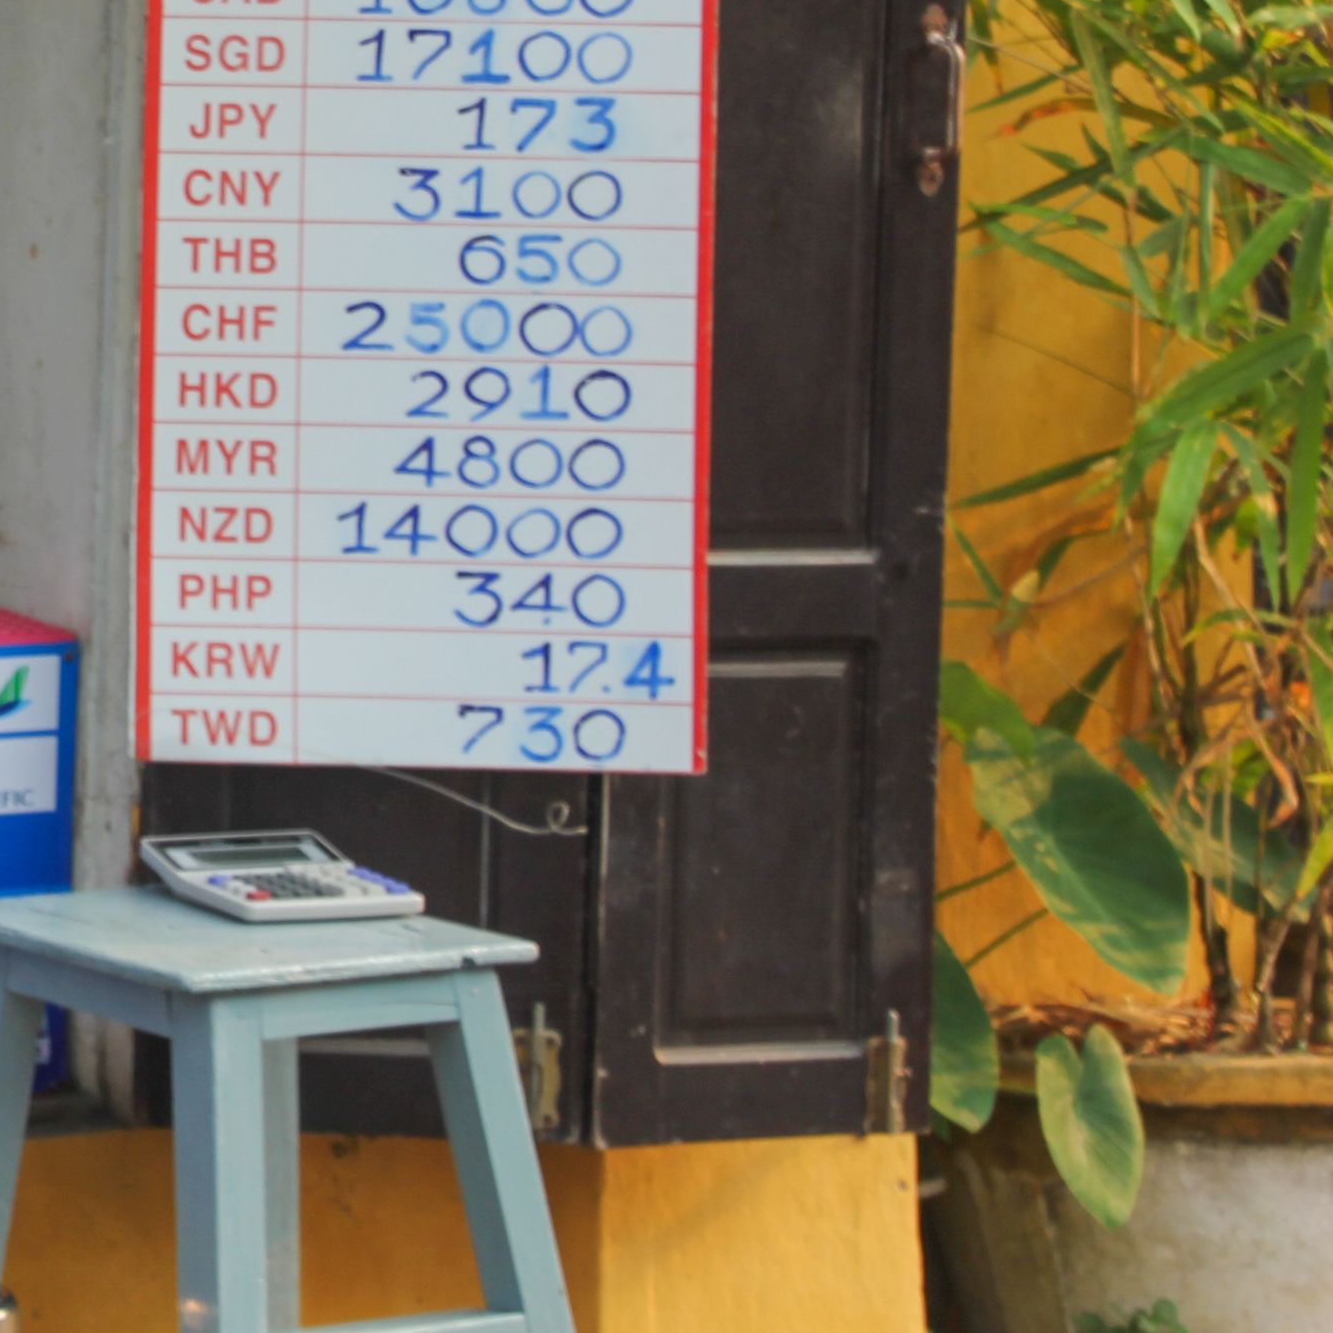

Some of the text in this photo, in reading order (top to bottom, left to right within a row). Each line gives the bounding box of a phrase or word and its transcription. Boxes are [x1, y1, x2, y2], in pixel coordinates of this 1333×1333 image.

[185, 28, 633, 85] SGD 17100
[189, 97, 617, 153] JPY 173
[183, 167, 623, 222] CNY 3100
[182, 234, 623, 287] THB 650
[181, 299, 633, 357] CHF 25000
[178, 365, 631, 422] HKD 2910
[175, 435, 626, 491] MYR 4800
[178, 502, 623, 559] NZD 14000
[179, 571, 625, 628] PHP 340
[171, 640, 674, 700] KRW 17.4
[171, 704, 625, 762] TWD 730
